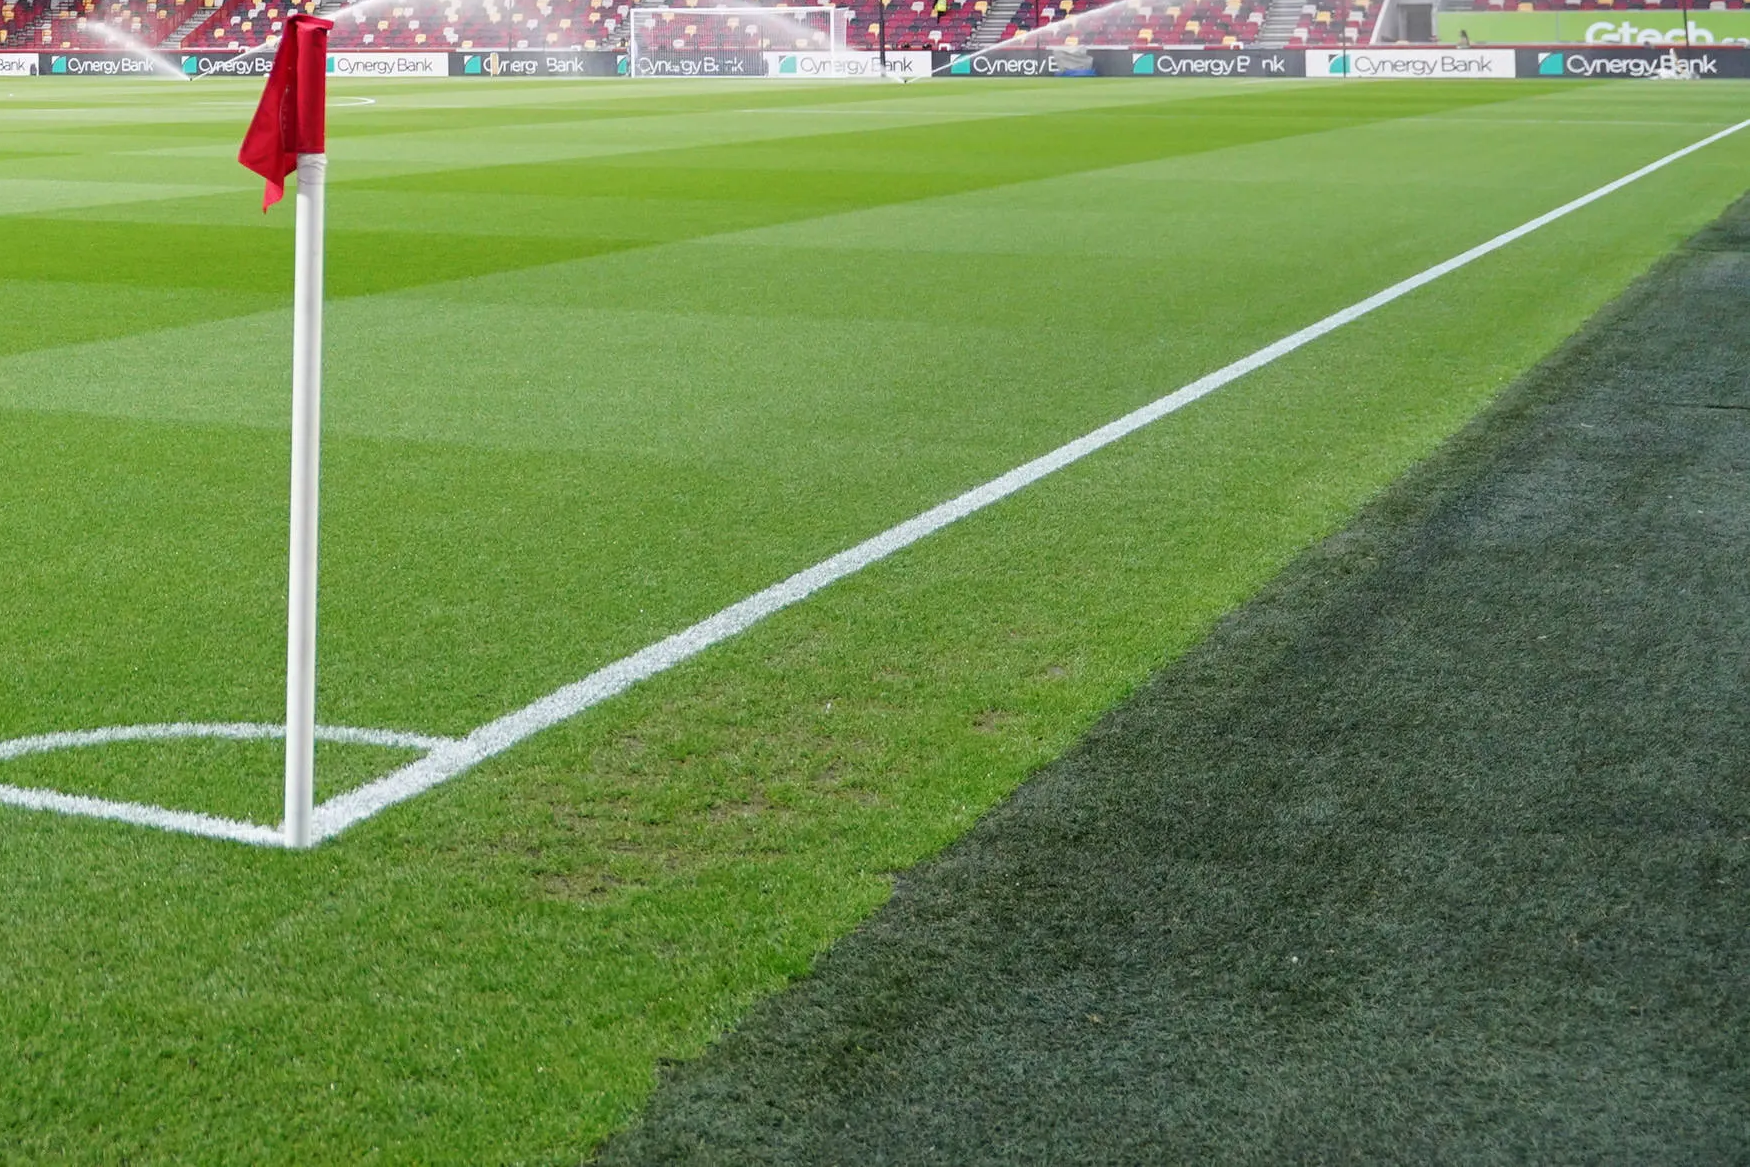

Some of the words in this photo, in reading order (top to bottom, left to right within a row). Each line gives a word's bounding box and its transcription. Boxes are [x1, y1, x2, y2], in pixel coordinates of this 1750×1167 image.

[68, 57, 121, 75] Cynergy
[121, 57, 154, 72] Bank
[198, 57, 253, 75] Cynergy
[254, 57, 274, 72] Ba
[337, 57, 395, 75] Cynergy
[397, 57, 433, 72] Bank
[483, 57, 538, 75] Cynerg
[546, 57, 584, 73] Bank
[638, 57, 702, 76] Cyngy
[800, 57, 869, 75] Cynergy
[972, 56, 1047, 75] Cynergy
[1157, 55, 1237, 75] Cynergy
[1237, 55, 1286, 73] Bnk
[1354, 55, 1439, 76] Cynergy
[1440, 55, 1492, 74] Bank
[1566, 54, 1657, 76] Cynergy
